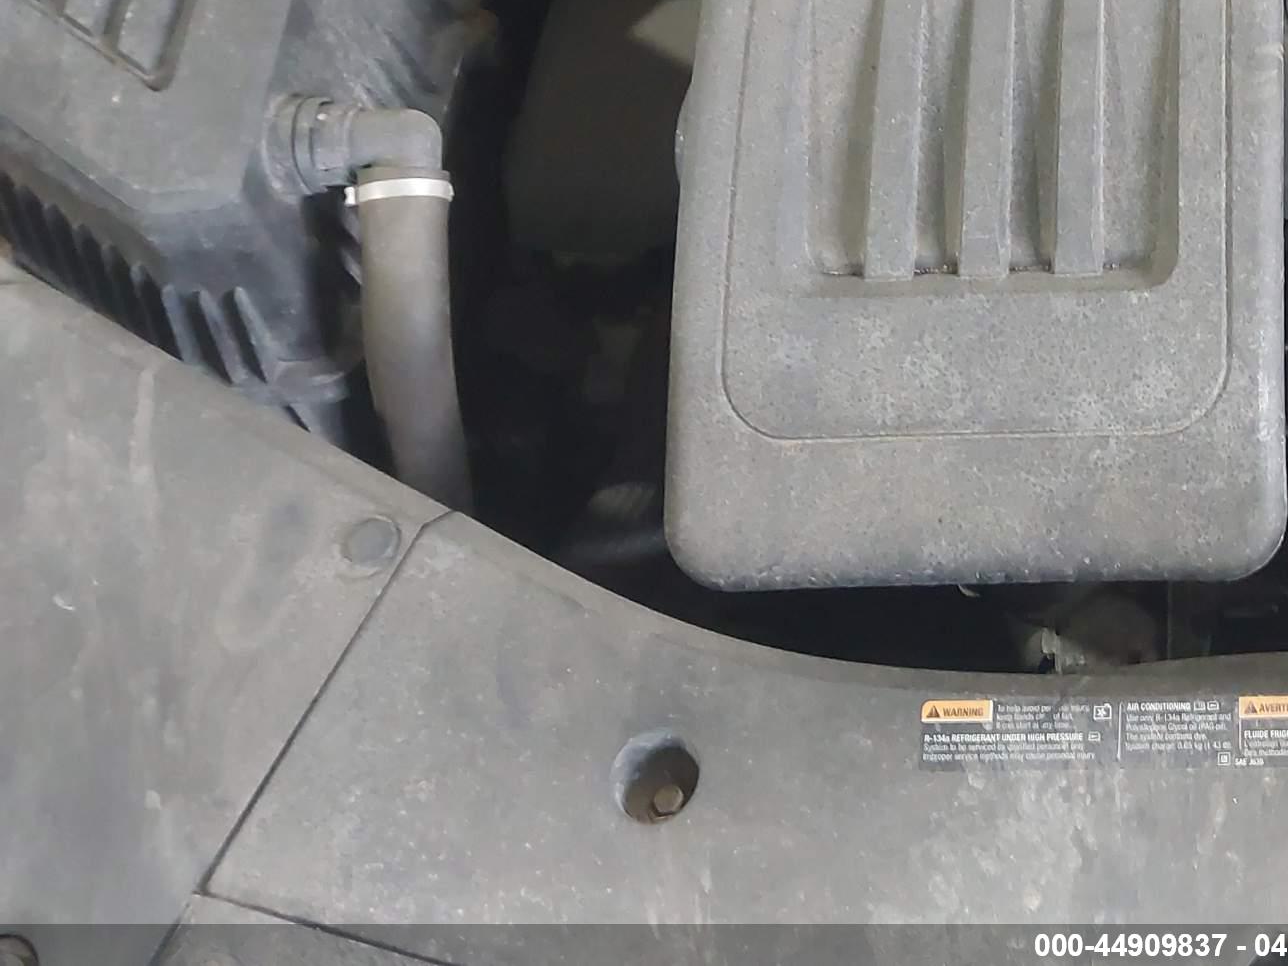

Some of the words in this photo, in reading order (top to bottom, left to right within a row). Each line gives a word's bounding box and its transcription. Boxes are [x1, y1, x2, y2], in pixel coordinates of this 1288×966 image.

[1127, 702, 1139, 710] AIR
[1140, 702, 1191, 710] CONDITIONING
[942, 706, 984, 717] WARNING
[924, 734, 950, 742] R-134a
[951, 733, 999, 742] REFRIGERANT
[1002, 733, 1026, 742] UNDER
[1027, 733, 1045, 742] HIGH
[1046, 733, 1083, 742] PRESSURE
[1244, 729, 1268, 738] FLUIDE
[1235, 758, 1248, 766] SAE
